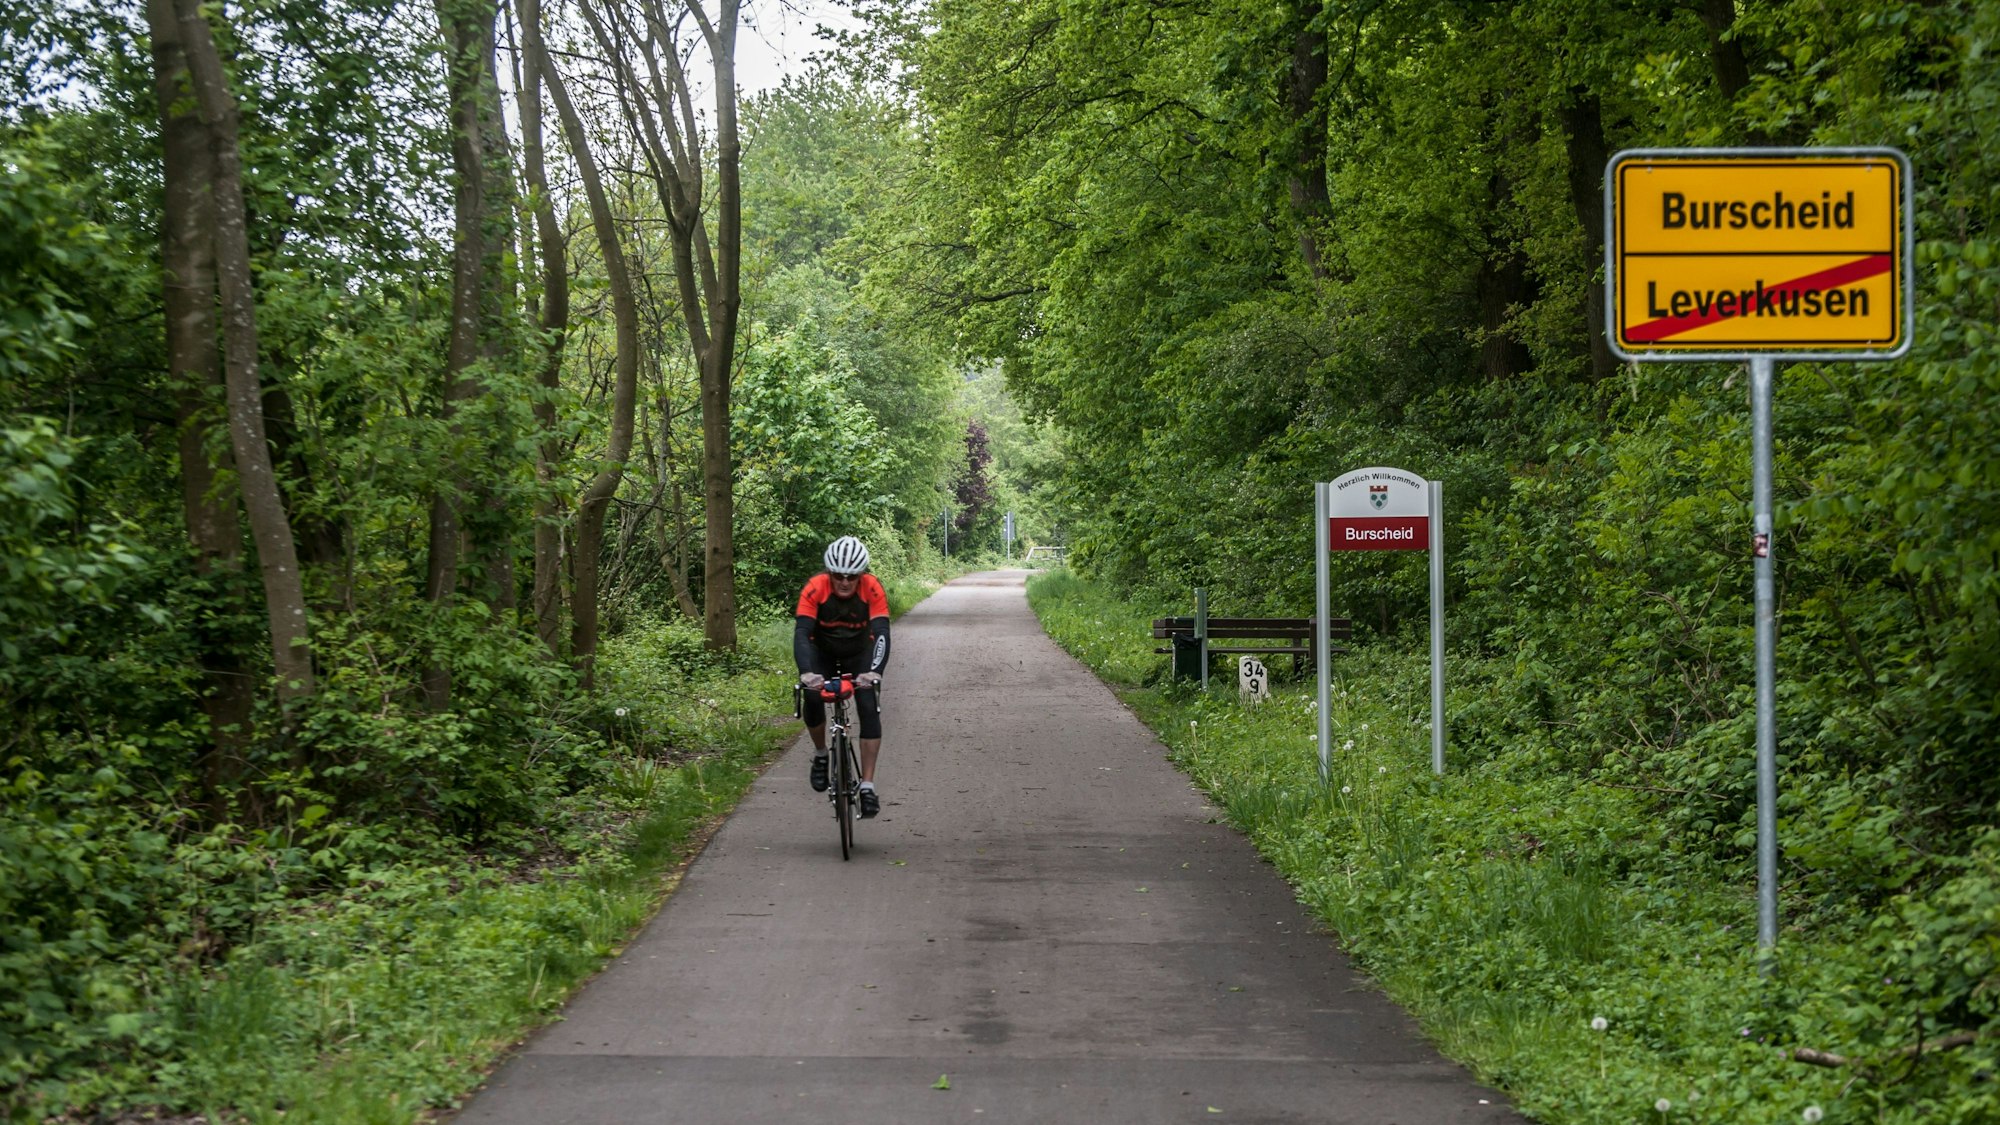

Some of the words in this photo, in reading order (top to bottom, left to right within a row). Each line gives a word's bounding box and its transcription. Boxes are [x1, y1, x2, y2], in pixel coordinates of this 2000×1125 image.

[1662, 191, 1854, 229] Burscheid
[1647, 280, 1870, 318] Leverkusen
[1337, 474, 1370, 491] Herzlich
[1371, 473, 1420, 490] Willkommen
[1345, 527, 1414, 540] Burscheid
[1243, 661, 1264, 678] 34
[1250, 678, 1259, 694] 9
